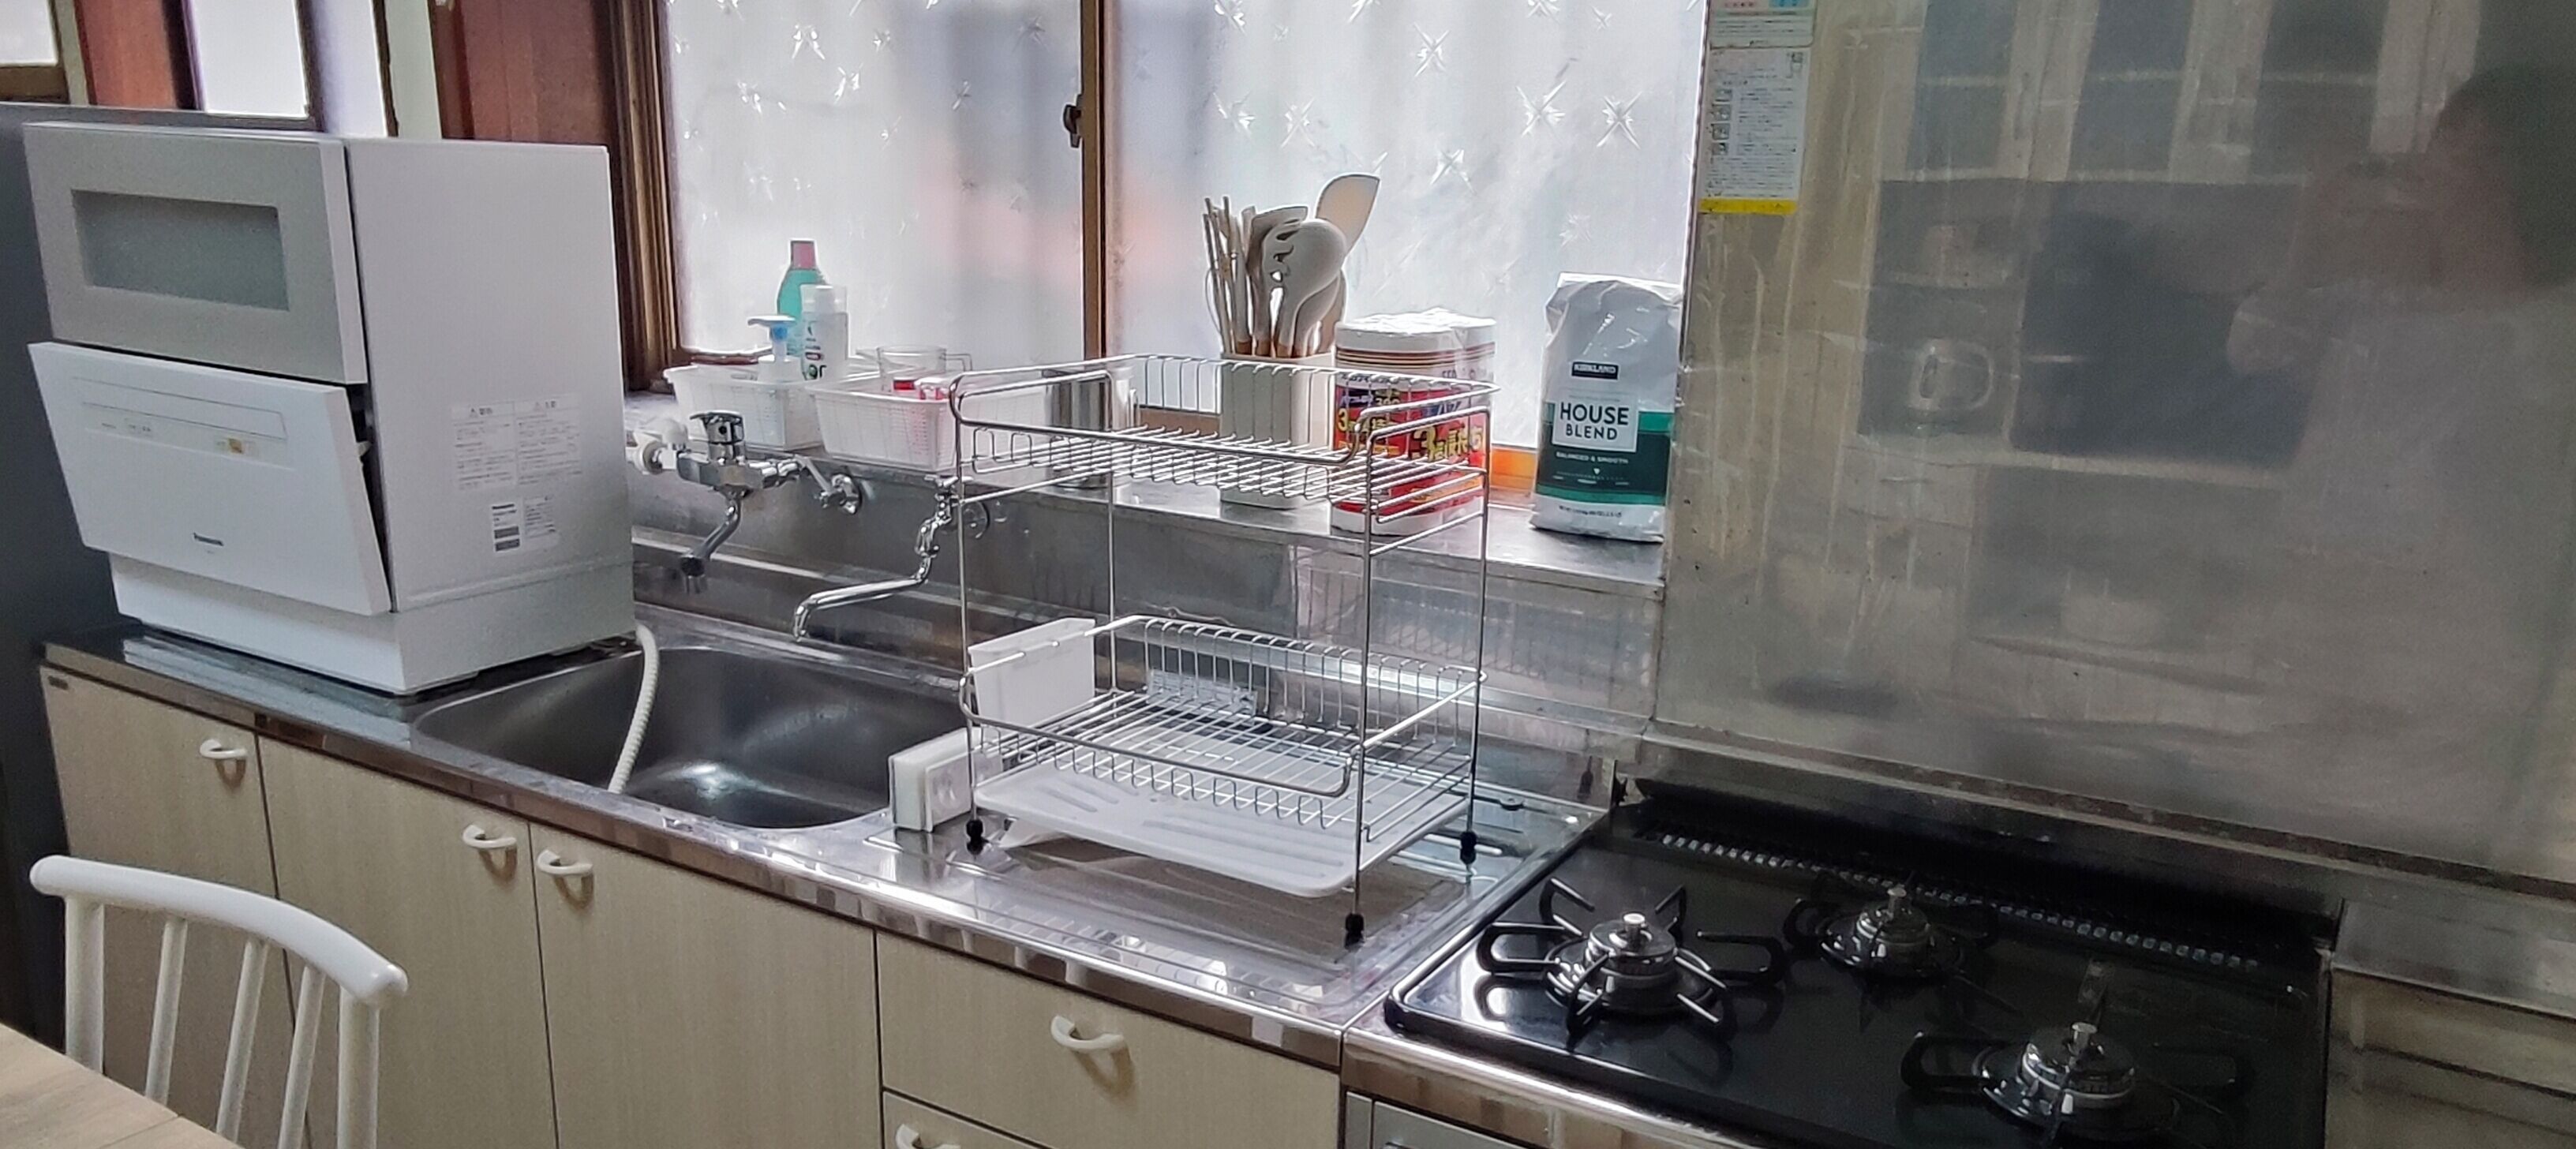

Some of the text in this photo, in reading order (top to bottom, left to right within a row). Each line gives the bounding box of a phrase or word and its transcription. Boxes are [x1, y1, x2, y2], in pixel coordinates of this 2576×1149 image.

[1574, 364, 1616, 374] KIRKLAND
[1560, 402, 1629, 425] HOUSE
[1566, 425, 1617, 440] BLEND
